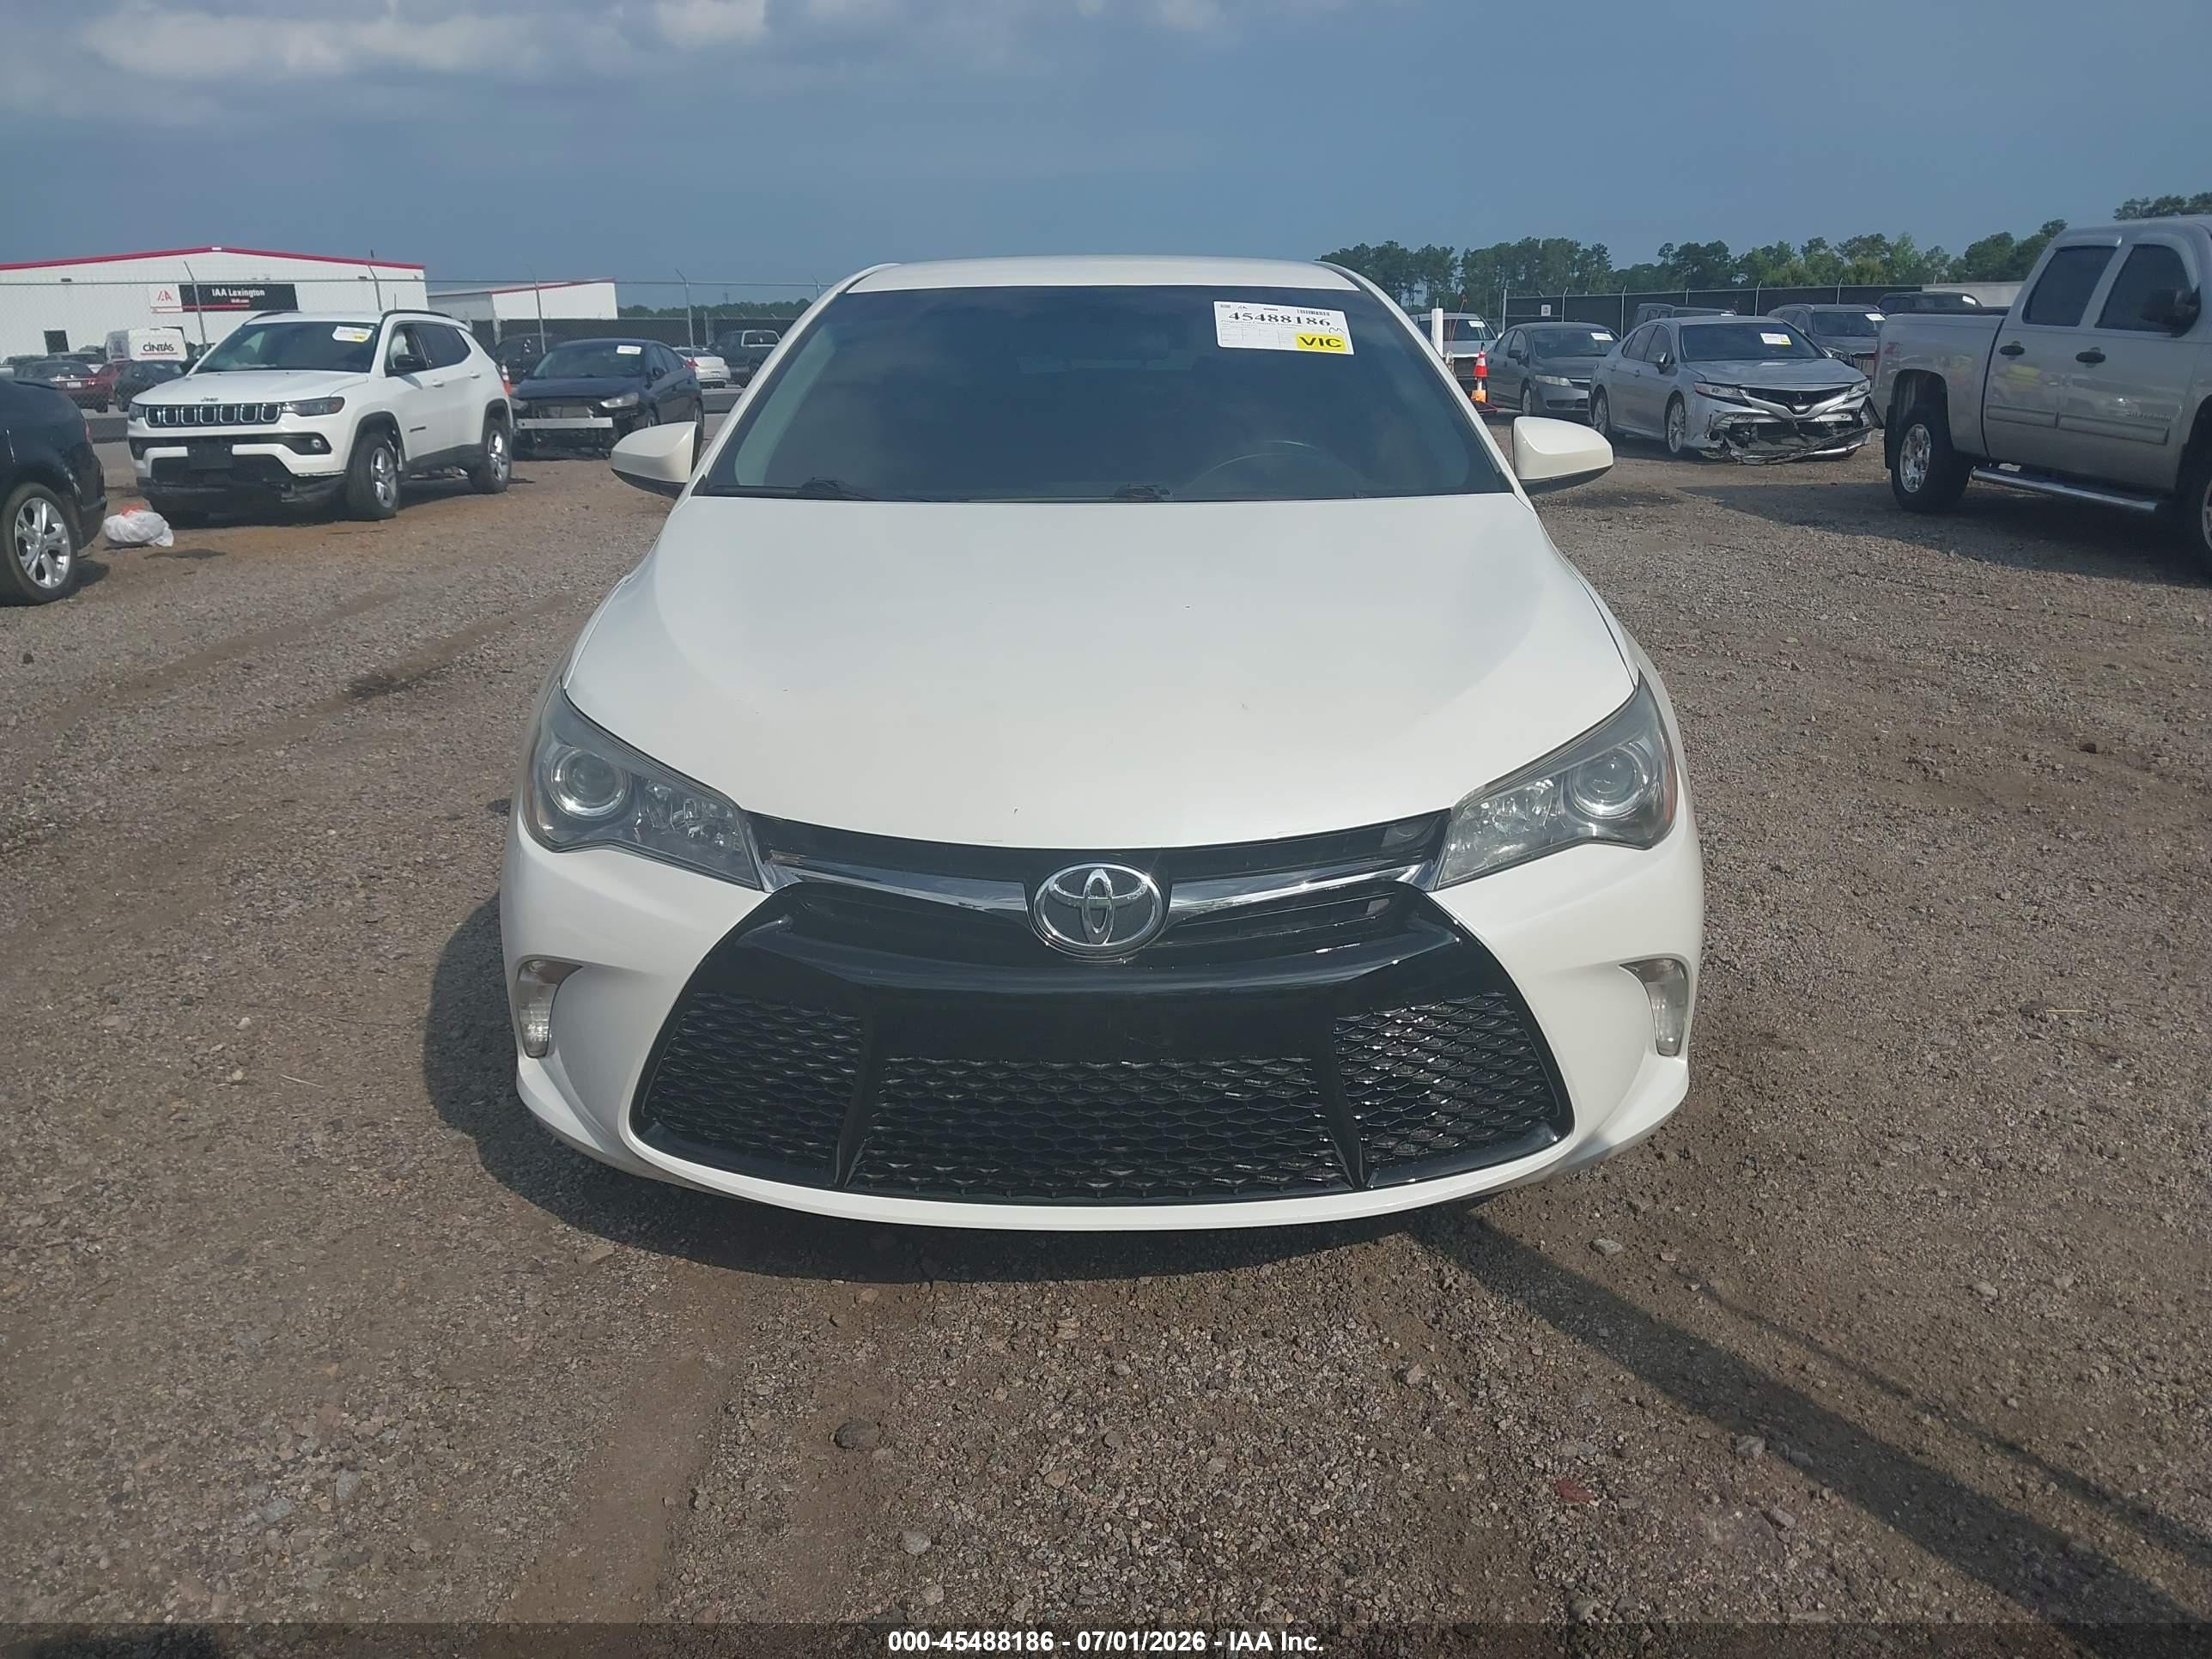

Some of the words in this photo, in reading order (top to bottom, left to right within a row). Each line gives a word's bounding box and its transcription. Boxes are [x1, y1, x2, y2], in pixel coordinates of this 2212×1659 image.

[211, 288, 228, 297] IAA
[228, 289, 265, 298] Lexington
[1228, 311, 1331, 327] 45488186
[1298, 336, 1342, 348] VIC
